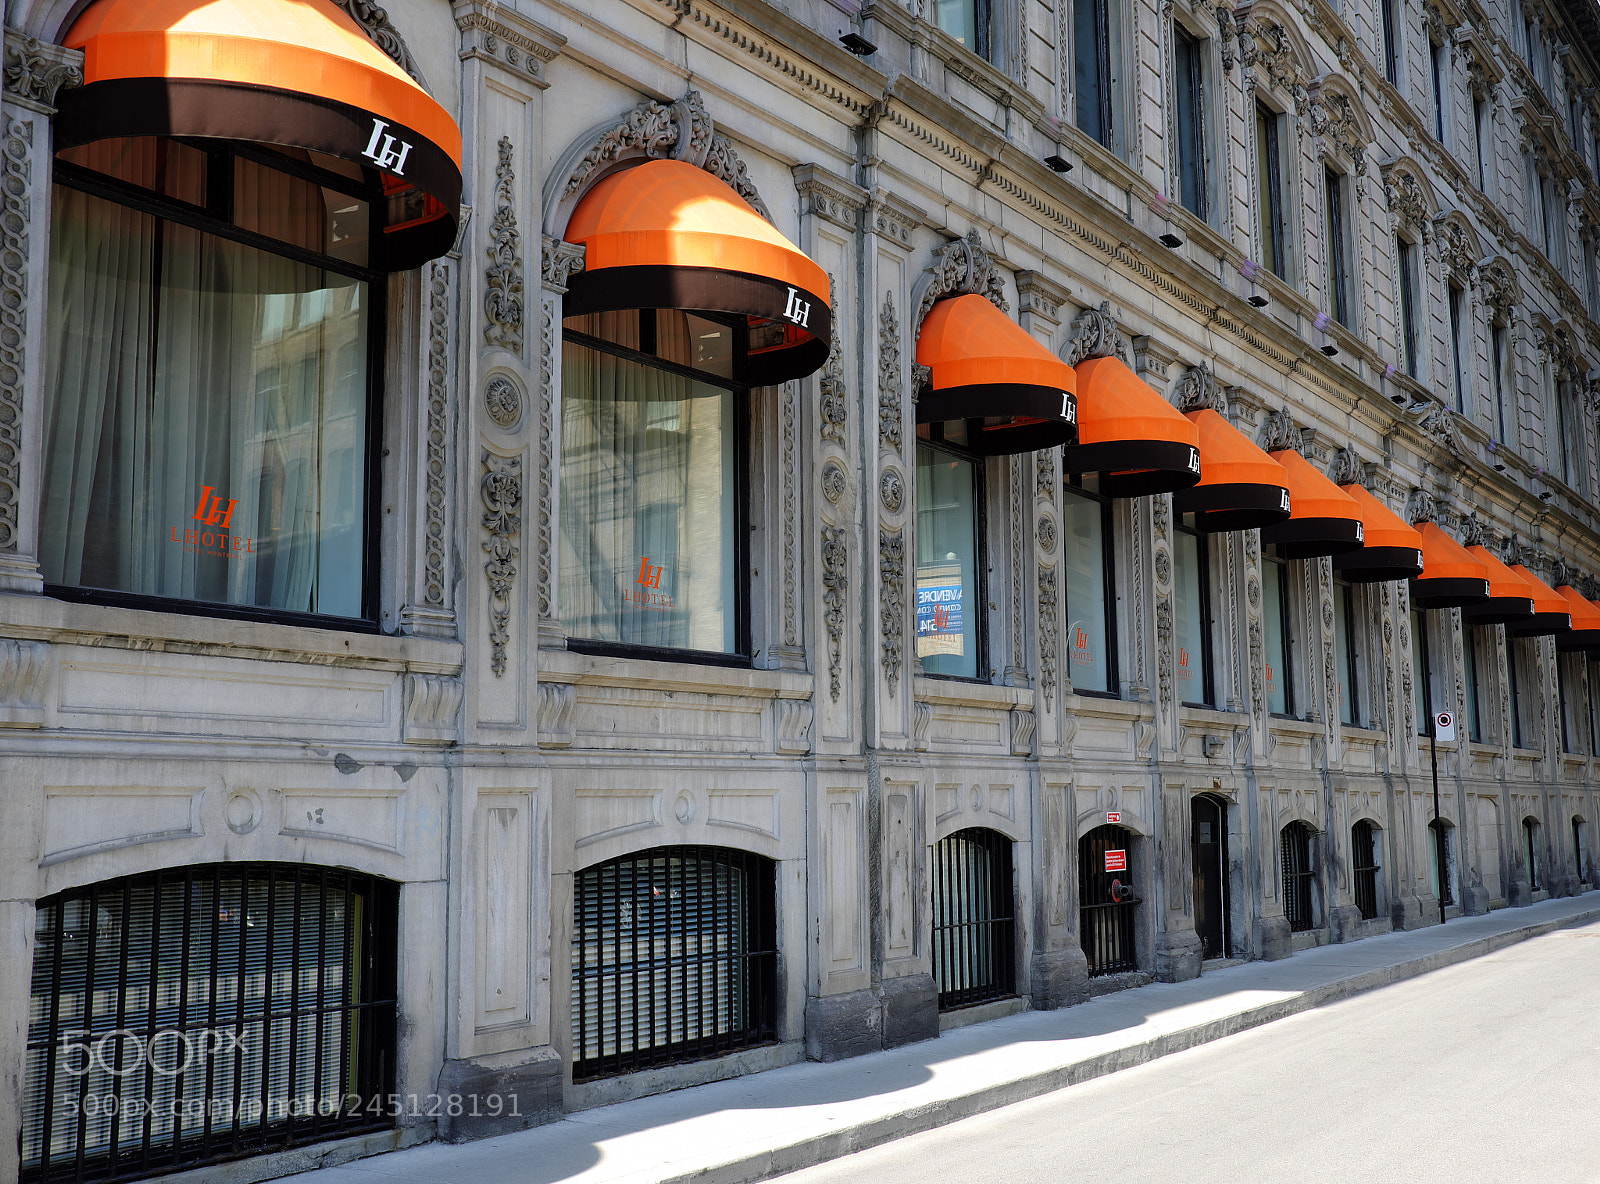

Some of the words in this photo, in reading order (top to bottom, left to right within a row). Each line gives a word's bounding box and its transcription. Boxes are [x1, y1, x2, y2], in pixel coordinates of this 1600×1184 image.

[361, 118, 413, 175] LH
[783, 286, 811, 328] LH
[1060, 392, 1076, 425] LH
[191, 485, 240, 528] LH
[170, 526, 256, 553] LHOTEL
[636, 556, 664, 589] LH
[625, 589, 675, 607] LHOTEL
